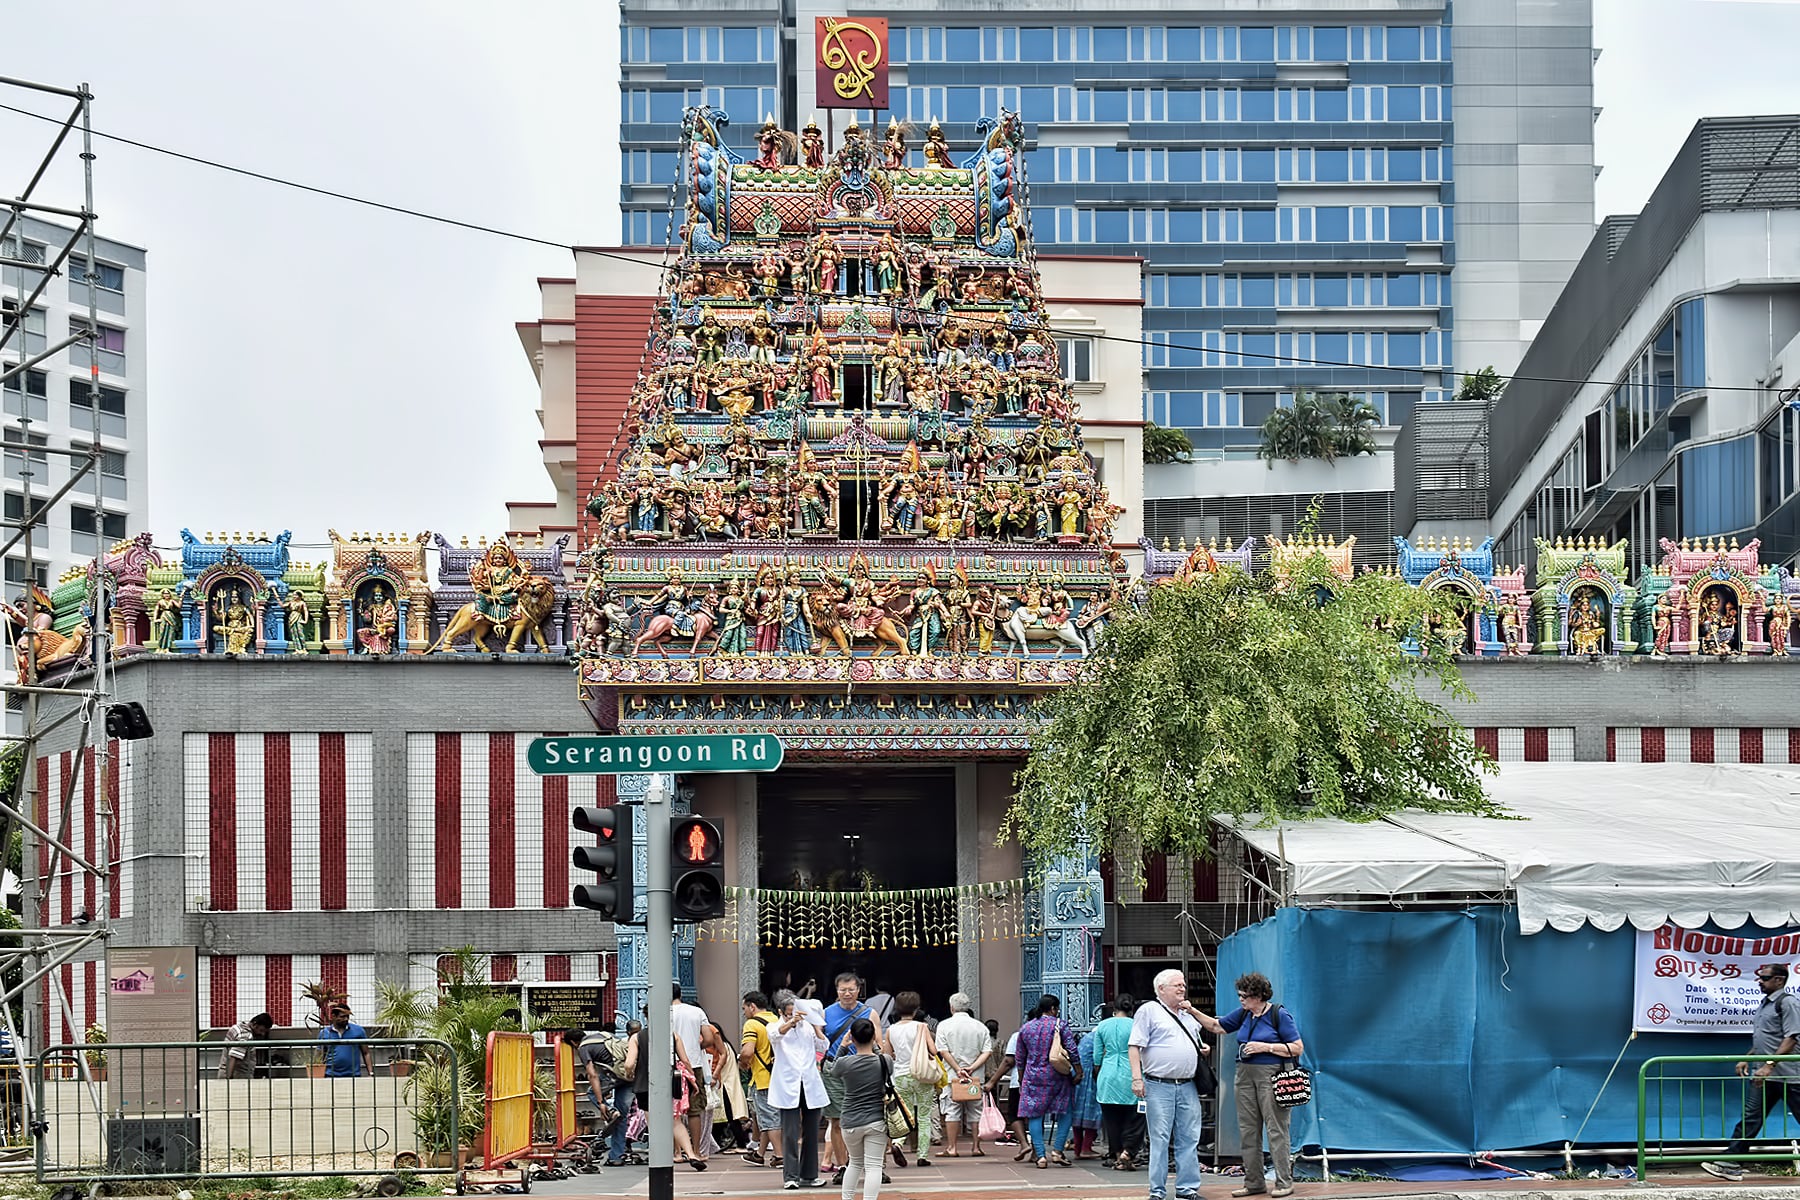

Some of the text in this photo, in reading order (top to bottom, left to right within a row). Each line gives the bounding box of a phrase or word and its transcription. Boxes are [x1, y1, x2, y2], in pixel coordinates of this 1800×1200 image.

[545, 738, 767, 768] Serangoon Rd
[1653, 954, 1742, 981] இரத்த
[1685, 983, 1708, 993] Date
[1737, 987, 1761, 995] Octo
[1685, 994, 1709, 1004] Time
[1720, 997, 1760, 1007] 12.00pm
[1684, 1006, 1719, 1015] Venue:
[1720, 1007, 1740, 1016] Pek
[1675, 1018, 1707, 1026] Organised
